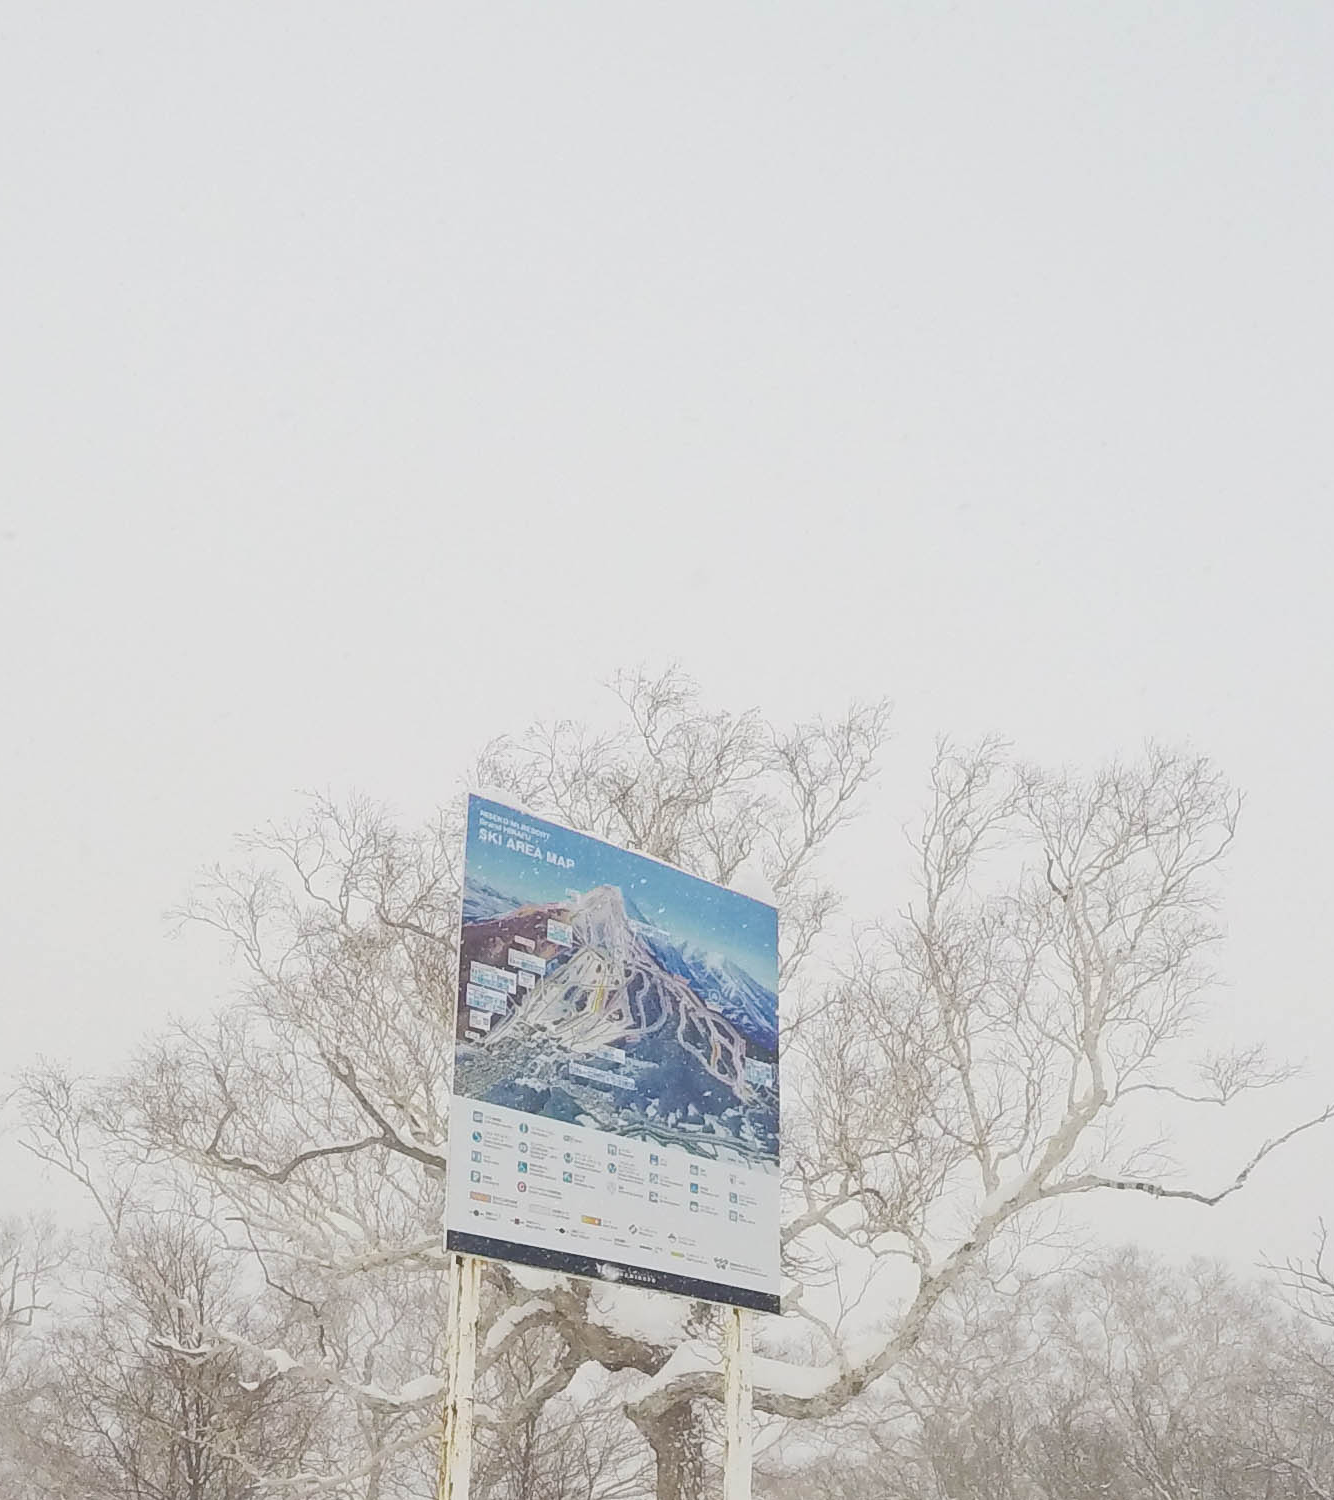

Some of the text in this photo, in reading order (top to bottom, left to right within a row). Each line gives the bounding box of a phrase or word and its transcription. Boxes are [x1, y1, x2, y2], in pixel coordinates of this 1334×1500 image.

[479, 828, 575, 869] SKI AREA MAP
